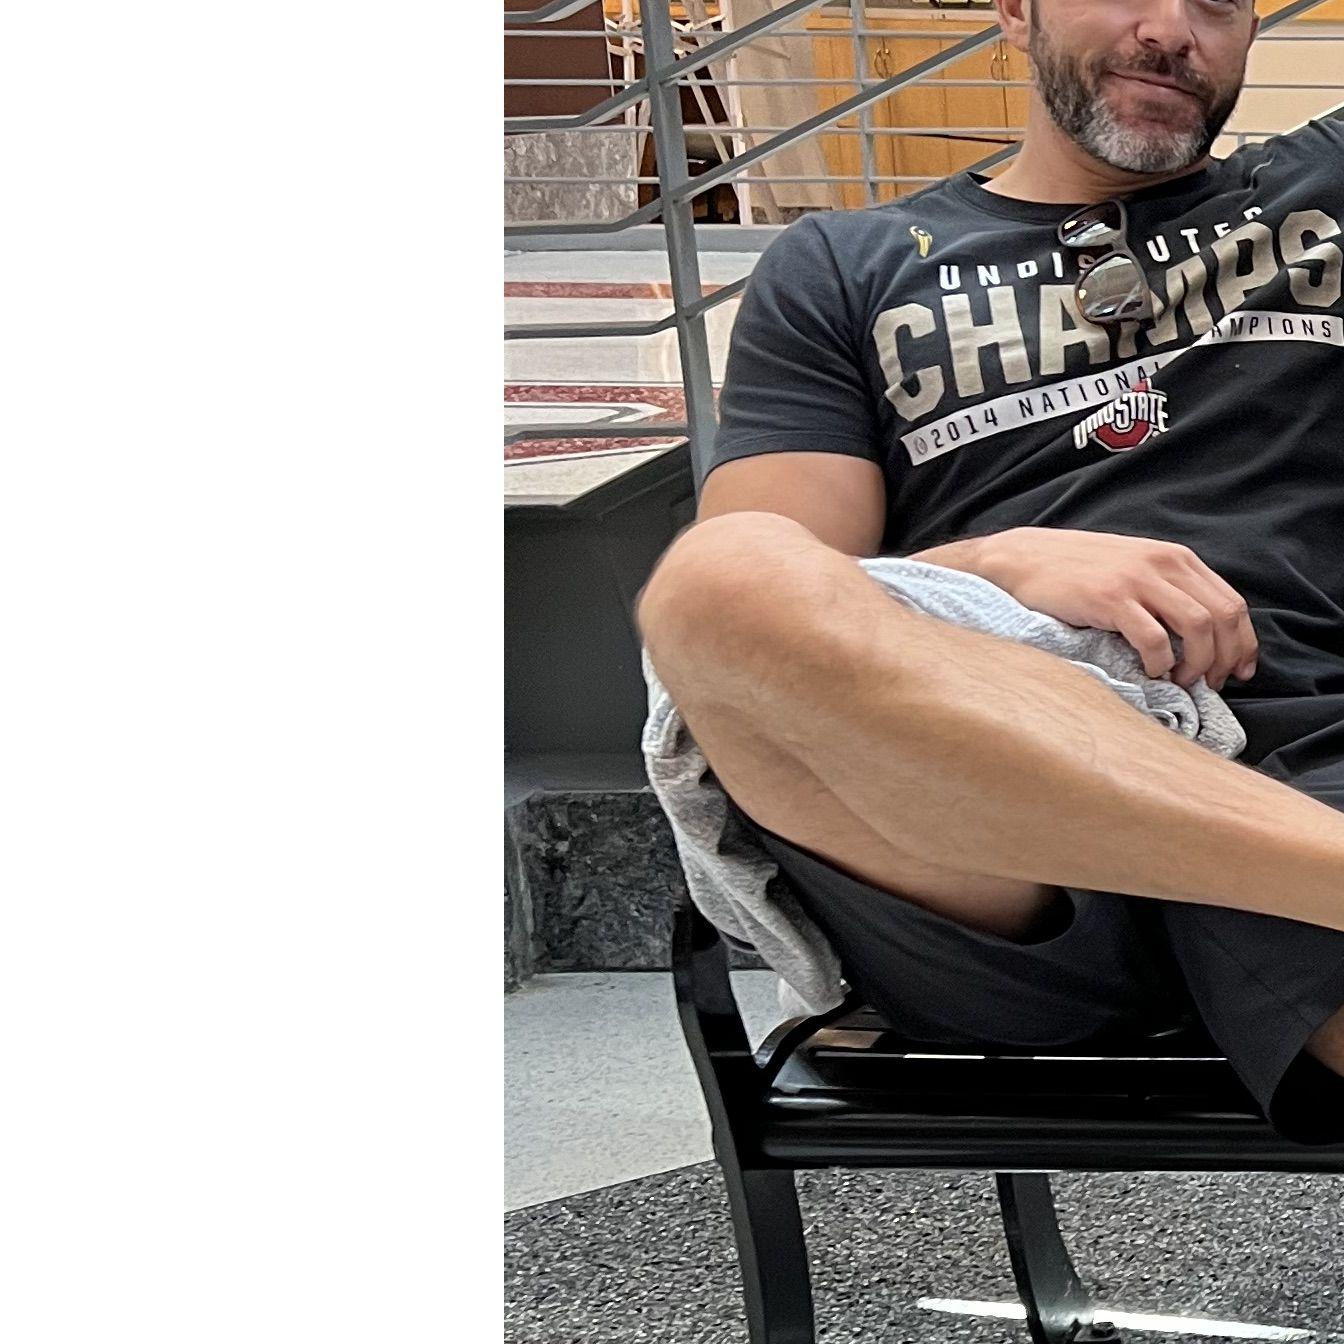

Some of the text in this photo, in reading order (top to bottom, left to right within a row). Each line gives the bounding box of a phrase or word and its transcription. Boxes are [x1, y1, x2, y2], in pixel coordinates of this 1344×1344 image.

[871, 209, 1343, 422] CHAMPS
[929, 407, 999, 449] 2014
[1210, 315, 1332, 338] AMPIONS
[1073, 391, 1170, 450] OHIO STATE
